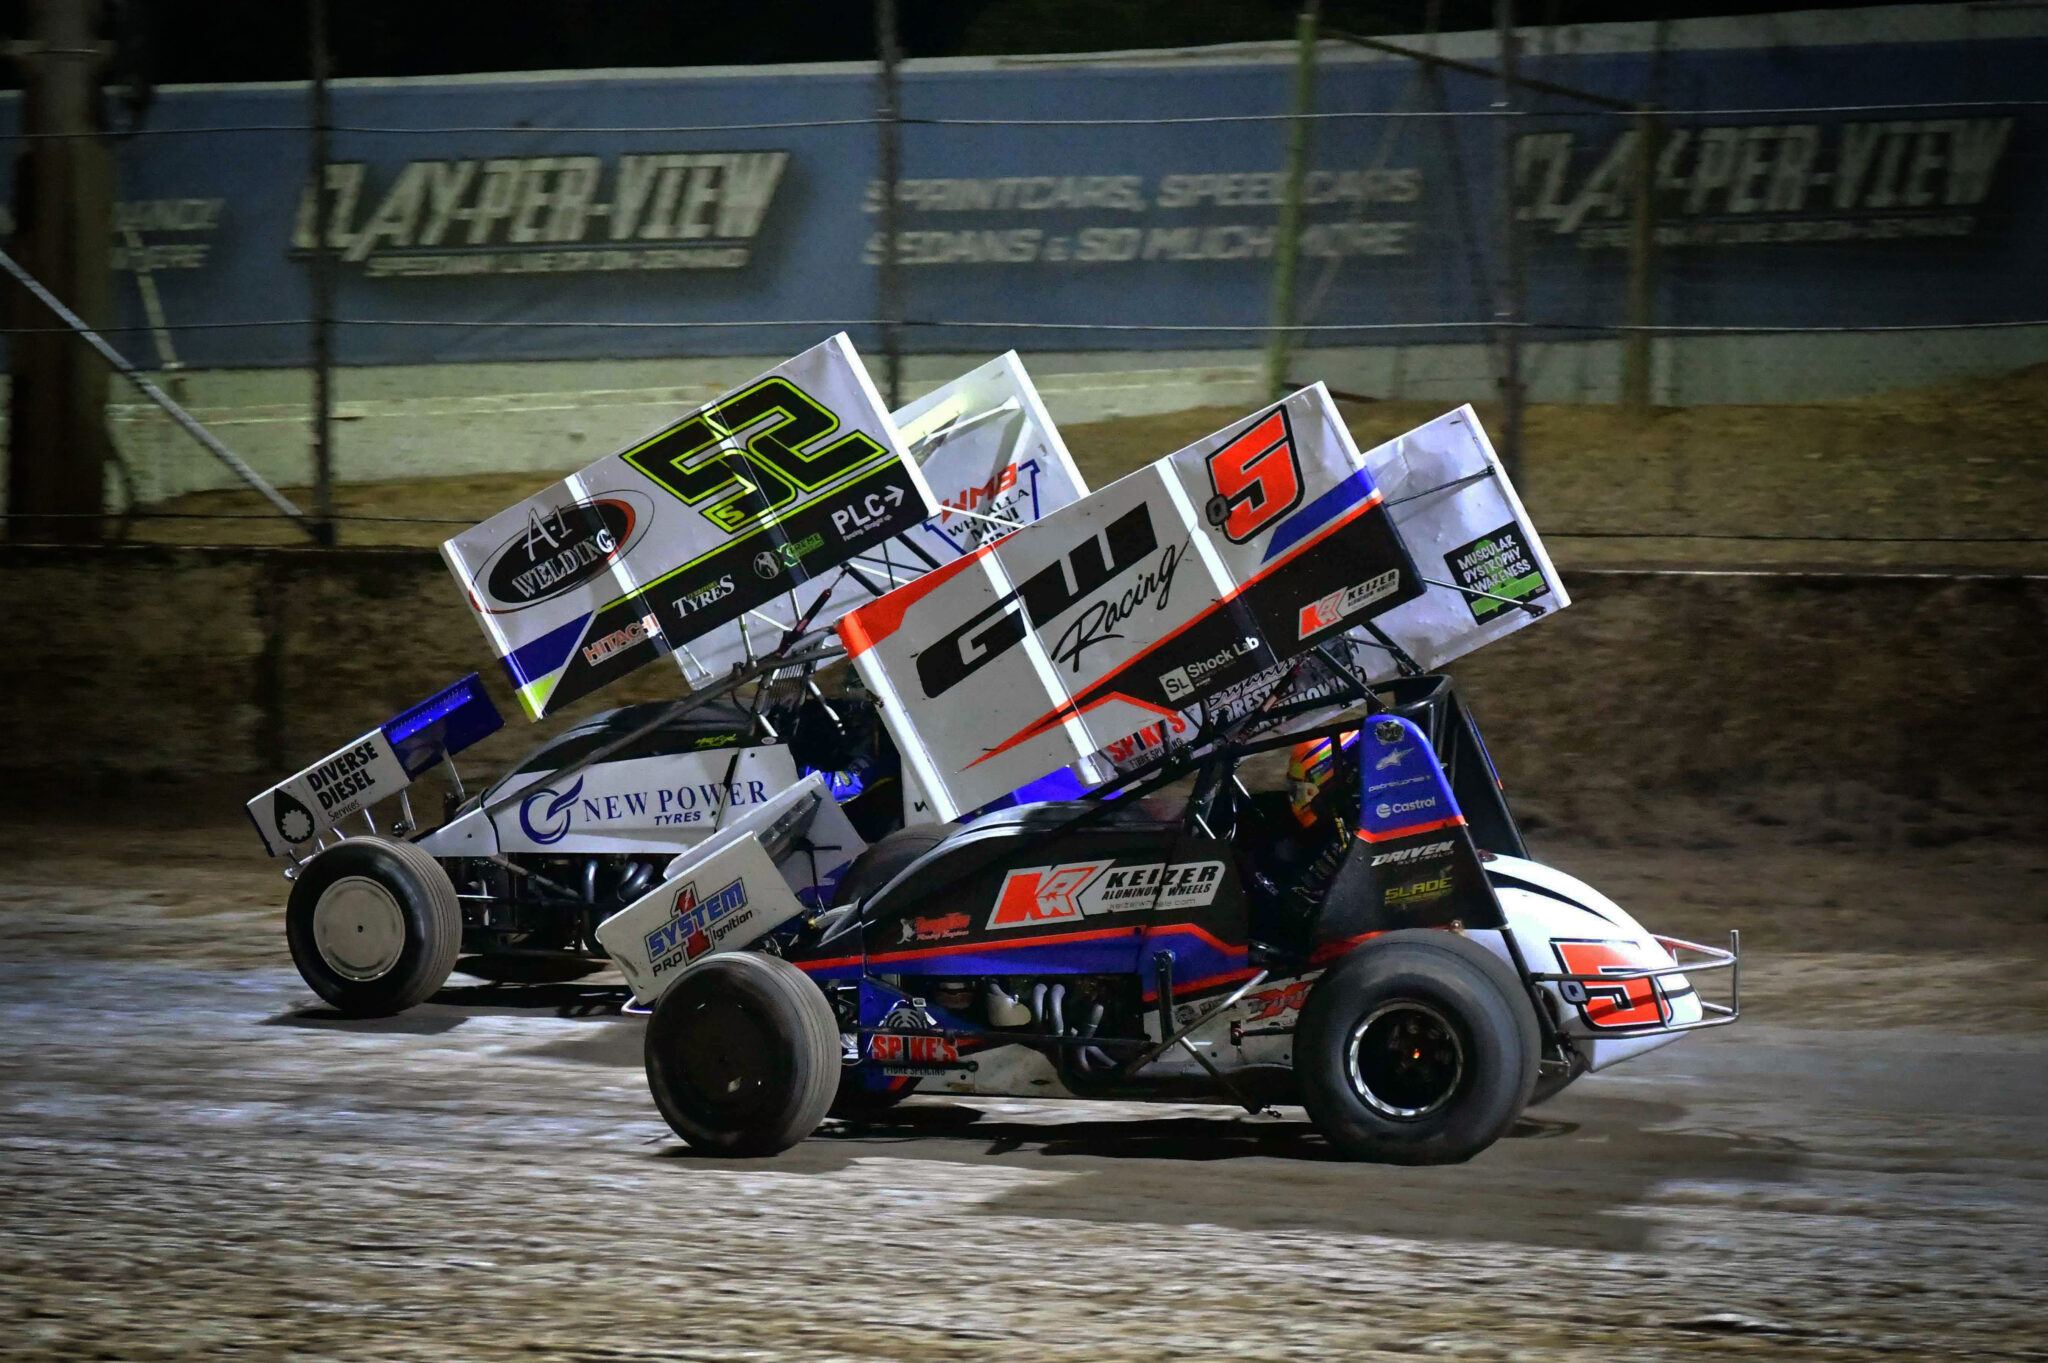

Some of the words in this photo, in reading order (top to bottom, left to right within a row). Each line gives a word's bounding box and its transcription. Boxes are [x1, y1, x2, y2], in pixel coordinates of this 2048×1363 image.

[619, 376, 889, 534] 52
[1205, 403, 1305, 545] 5
[831, 494, 885, 534] PLC
[522, 505, 573, 562] A-1
[1457, 534, 1517, 570] MUSCULAR
[512, 528, 616, 598] WELDING
[1463, 546, 1521, 583] DYSTROPHY
[1470, 559, 1531, 593] AWARENESS
[672, 574, 735, 618] TYRES
[1050, 524, 1195, 673] Racing
[1348, 572, 1396, 600] KEIZER
[583, 614, 659, 661] HITACHI
[1187, 649, 1234, 678] Shock
[1232, 637, 1260, 656] Lab
[1165, 677, 1189, 694] SL
[306, 741, 379, 793] DIVERSE
[317, 769, 375, 810] DIESEL
[582, 791, 648, 822] NEW
[657, 780, 768, 813] POWER
[1392, 796, 1436, 814] Castrol
[327, 800, 361, 823] Services
[654, 810, 701, 826] TYRES
[1370, 840, 1455, 867] DRIVEN
[1102, 886, 1161, 901] ALUMINUM
[1167, 883, 1211, 897] WHEELS
[1106, 866, 1219, 889] KEIZER
[1384, 876, 1453, 899] SLADE
[649, 882, 746, 957] SYSTEM
[712, 909, 754, 942] Ignition
[652, 953, 683, 977] PRO
